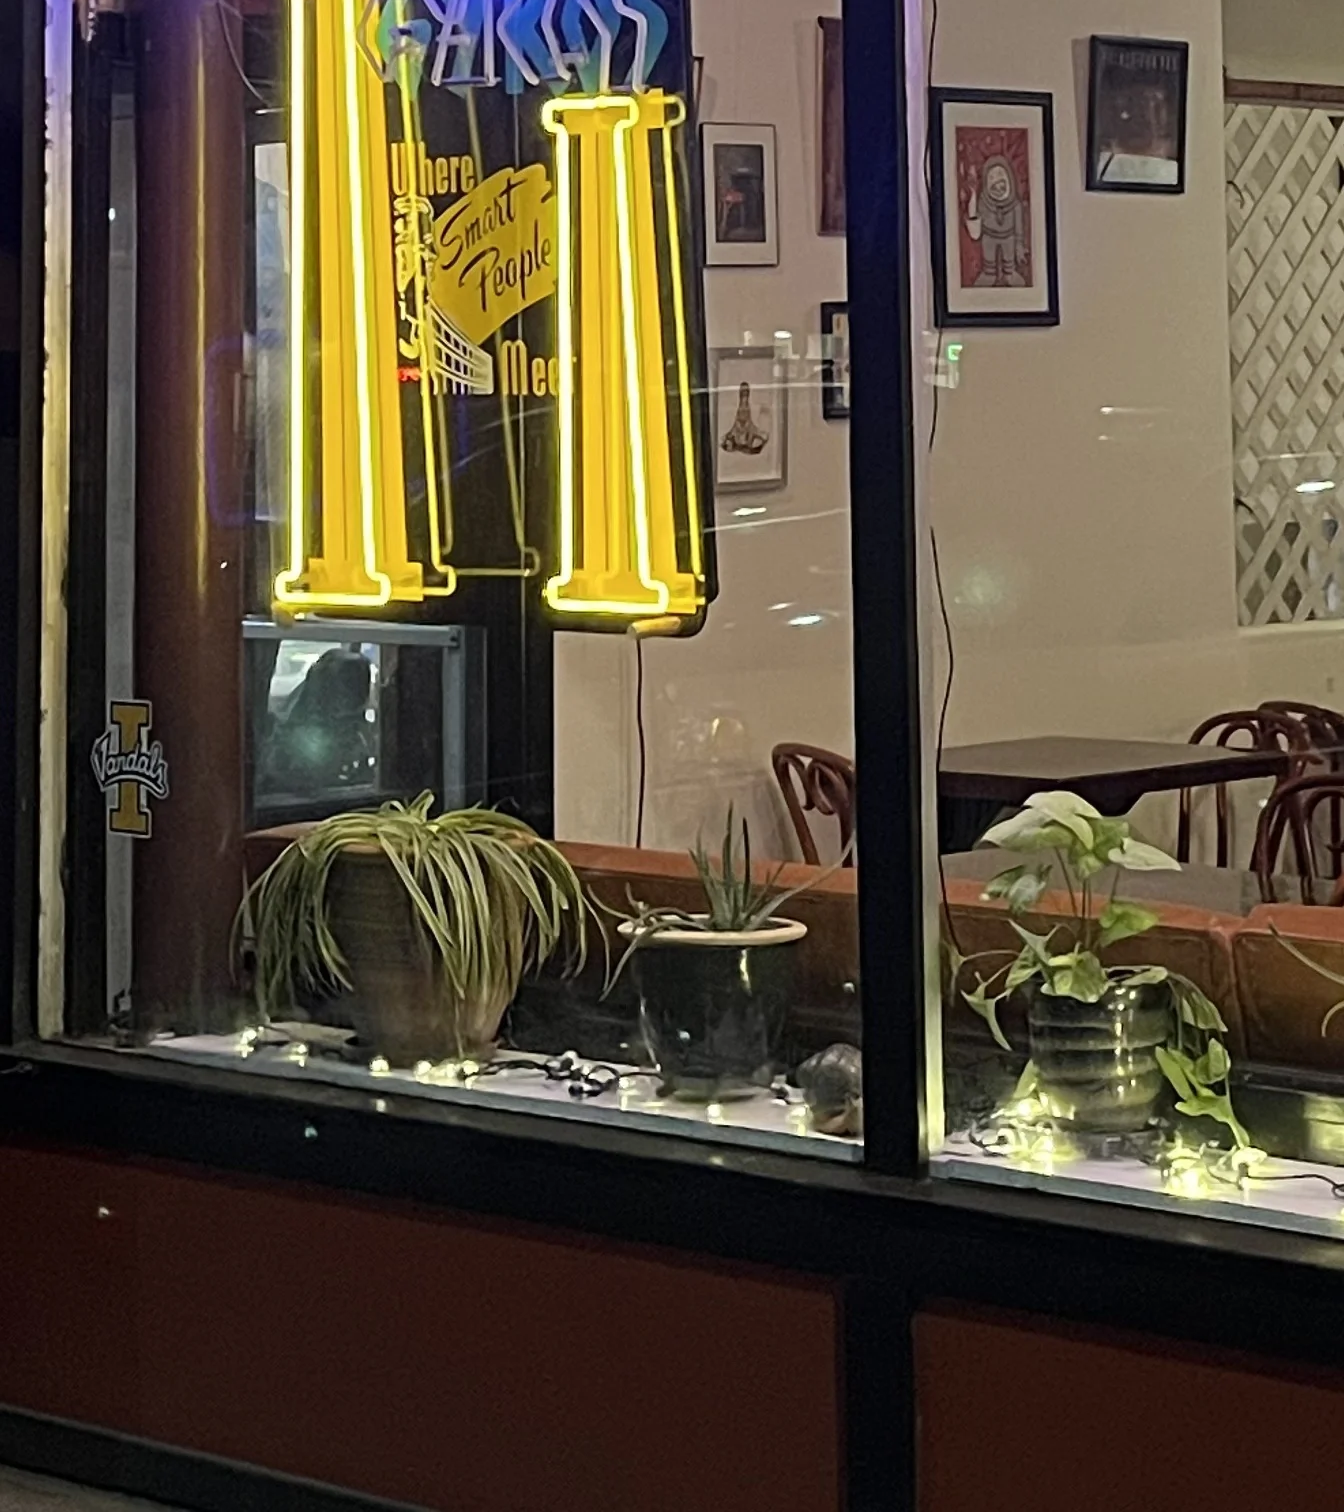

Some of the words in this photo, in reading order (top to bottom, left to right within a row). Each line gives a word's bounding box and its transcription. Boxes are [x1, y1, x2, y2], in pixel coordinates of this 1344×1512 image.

[391, 142, 475, 197] Where
[440, 178, 527, 270] Smart
[459, 219, 552, 313] People
[93, 733, 168, 794] Vandals
